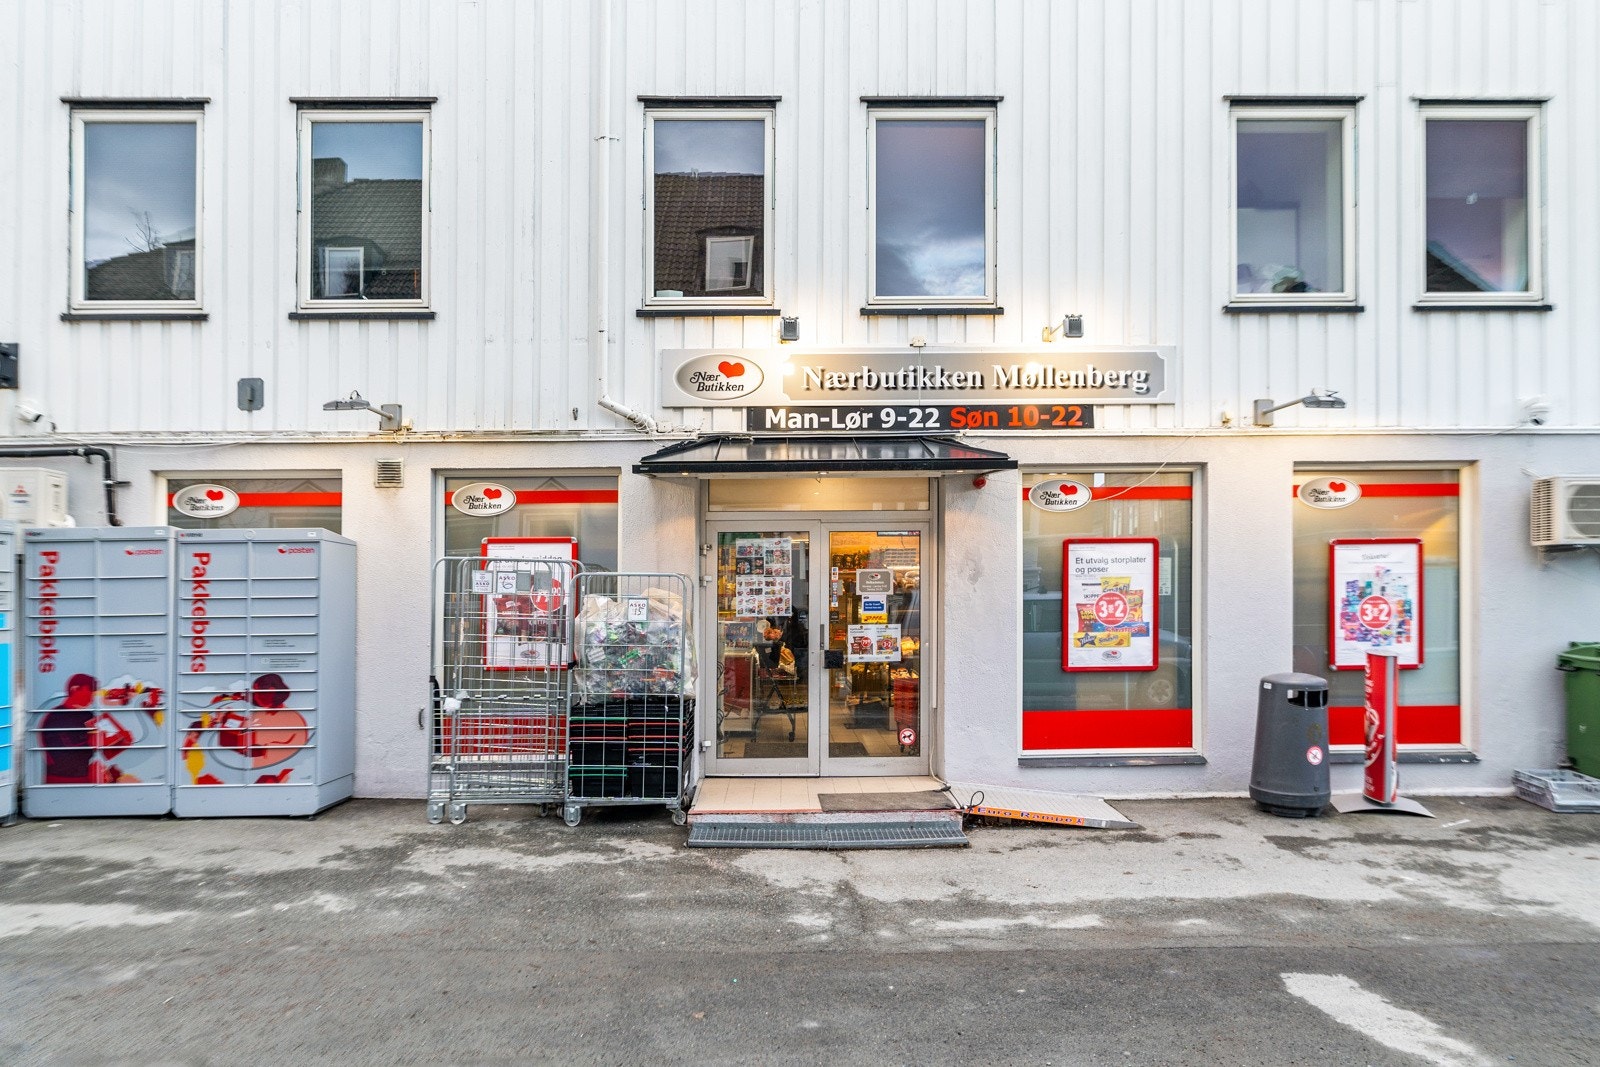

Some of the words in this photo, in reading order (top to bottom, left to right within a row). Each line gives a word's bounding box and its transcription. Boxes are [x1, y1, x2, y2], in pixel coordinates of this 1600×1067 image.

[689, 371, 721, 384] Nær
[801, 365, 983, 390] Nærbutikken
[992, 364, 1150, 393] Møllenberg
[696, 381, 744, 392] Butikken
[765, 408, 873, 430] Man-Lør
[880, 408, 941, 428] 9-22
[950, 407, 999, 429] Søn
[1008, 406, 1083, 427] 10-22
[463, 495, 485, 504] Nær
[1039, 491, 1061, 500] Nær
[468, 502, 502, 510] Butikken
[1044, 498, 1078, 506] Butikken
[288, 547, 315, 555] posten
[1085, 557, 1109, 565] utvalg
[1110, 556, 1147, 564] storplater
[38, 551, 60, 673] Pakkeboks
[191, 552, 211, 673] Pakkeboks
[1098, 600, 1108, 618] 3
[1114, 600, 1125, 618] 2
[1362, 603, 1373, 621] 3
[1378, 603, 1389, 621] 2
